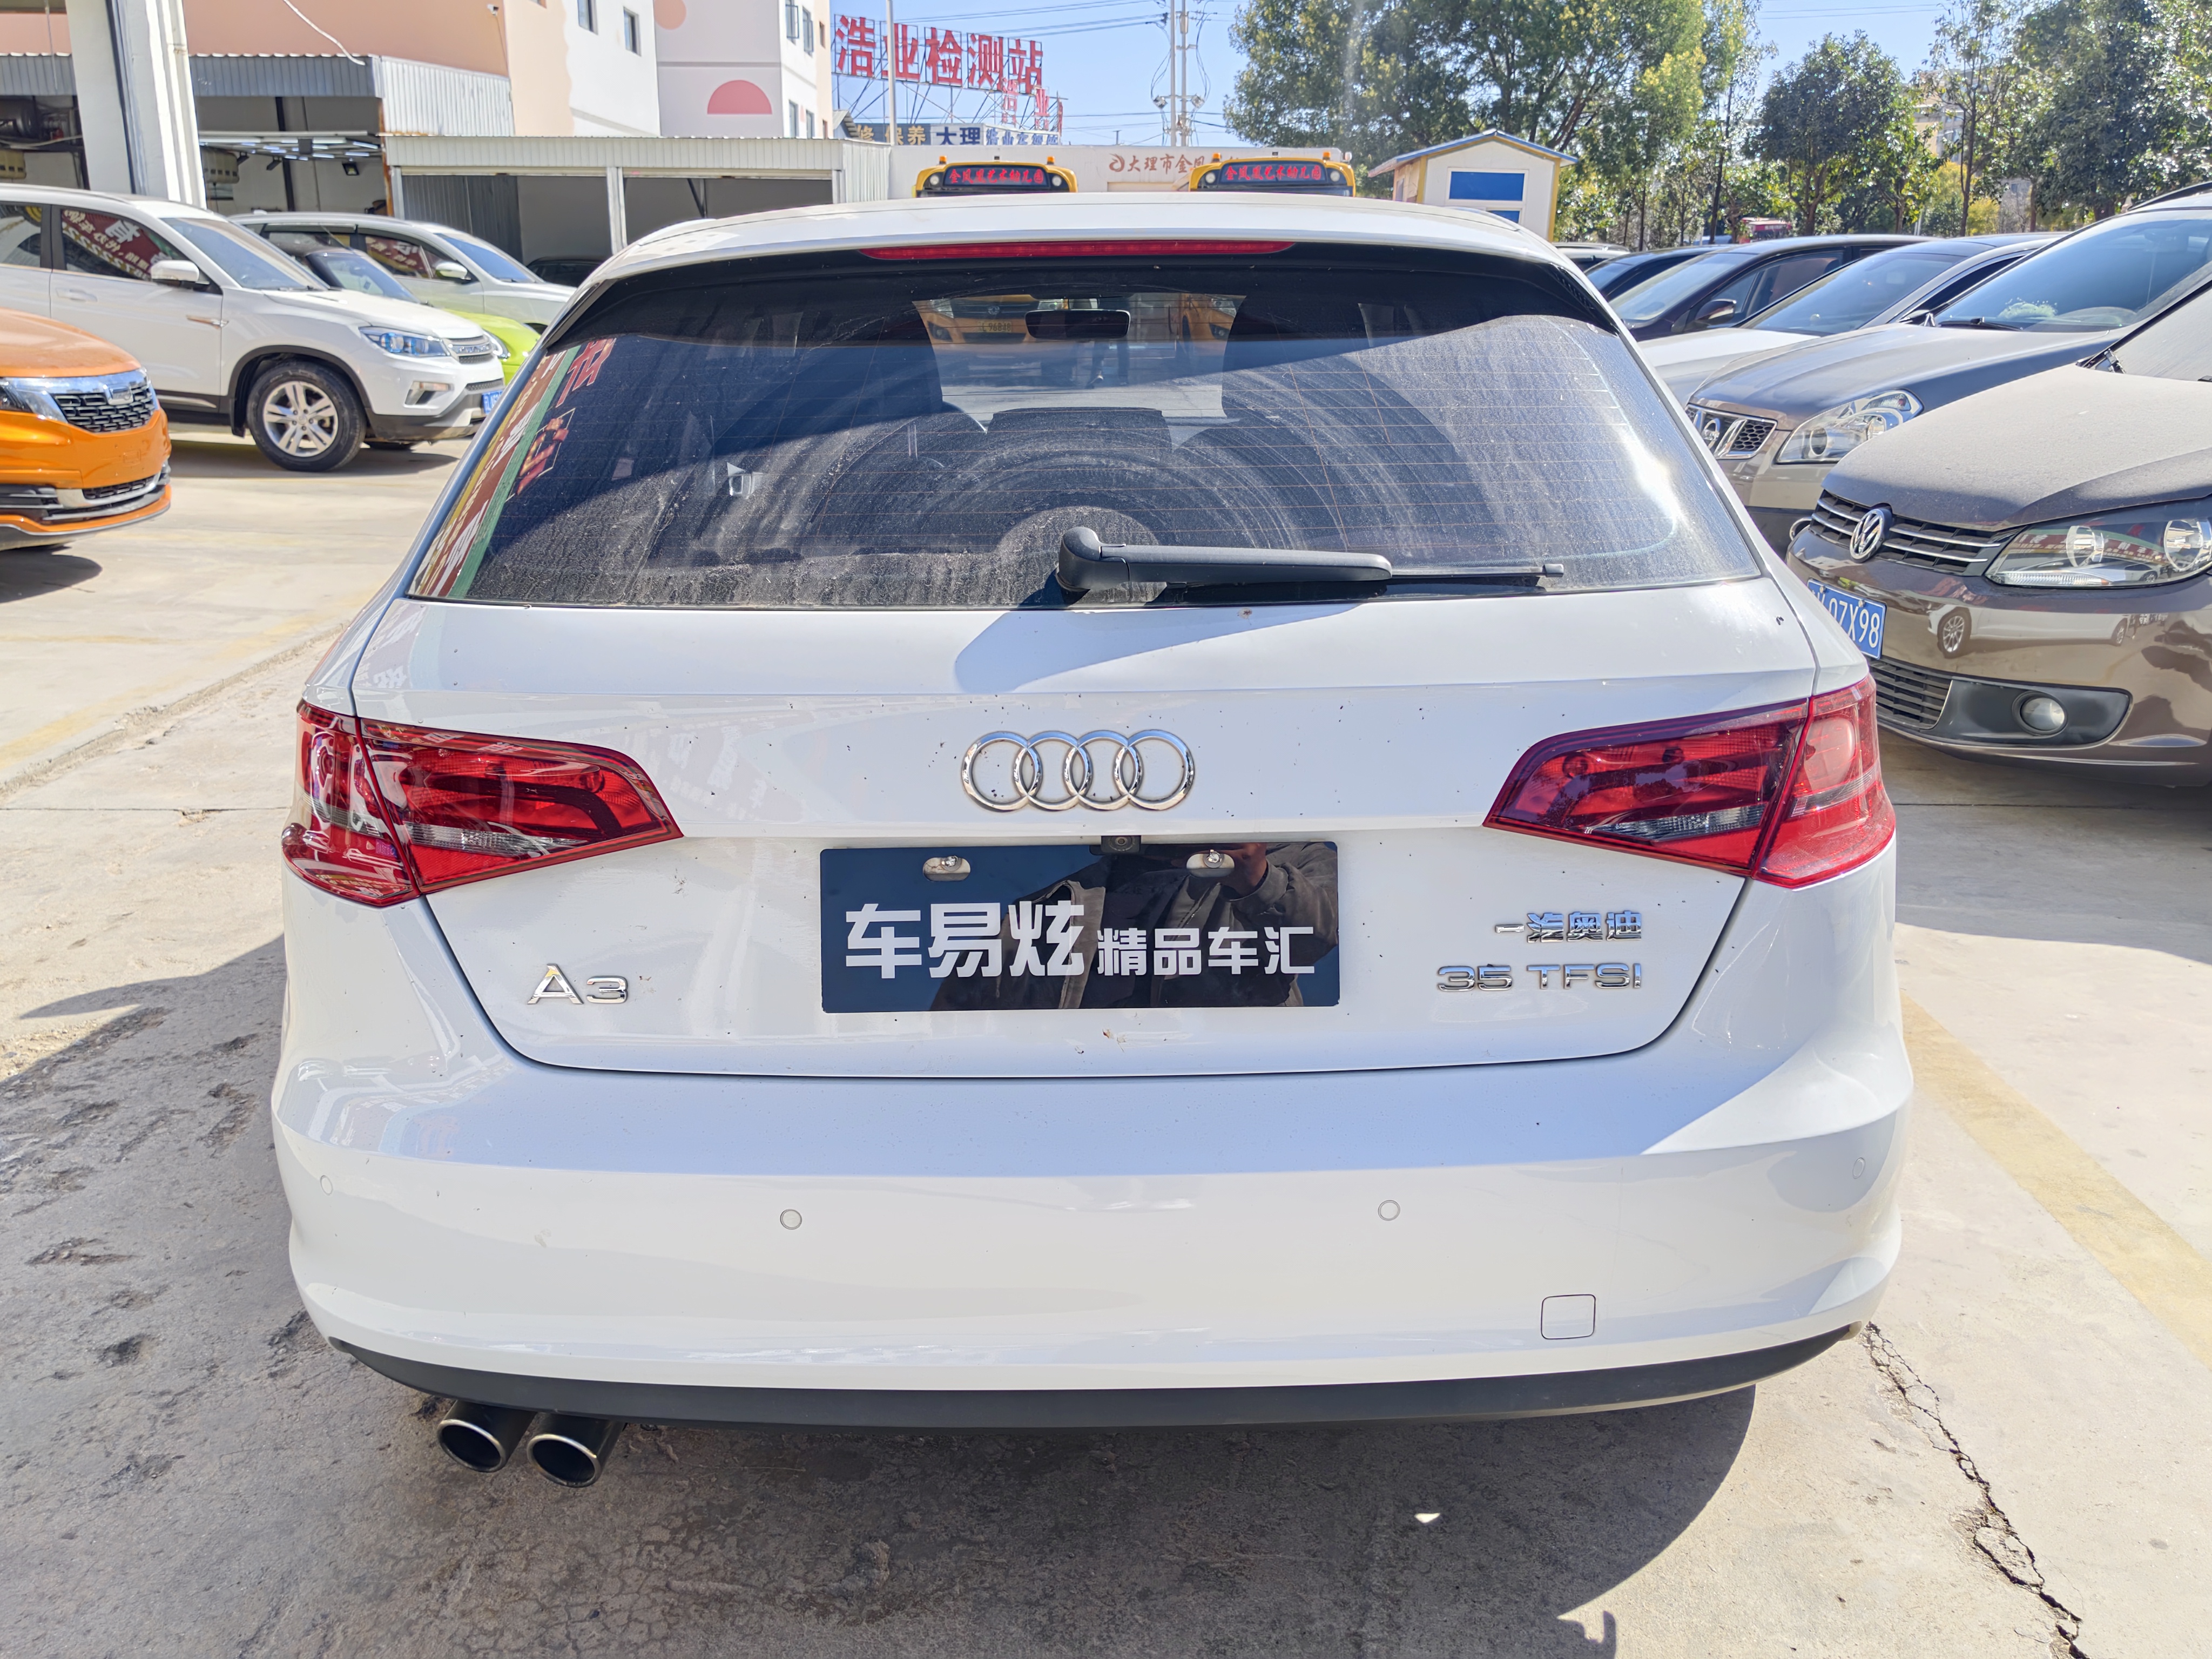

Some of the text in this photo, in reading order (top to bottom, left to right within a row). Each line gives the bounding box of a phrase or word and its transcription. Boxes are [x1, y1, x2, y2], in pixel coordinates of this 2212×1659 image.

[835, 15, 1043, 94] 浩业检测站
[936, 126, 980, 145] 大理
[845, 900, 1314, 979] 车易炫 精品车汇
[1494, 911, 1642, 943] 一汽奥迪
[527, 963, 629, 1005] A3
[1438, 963, 1642, 992] 35 TFSI
